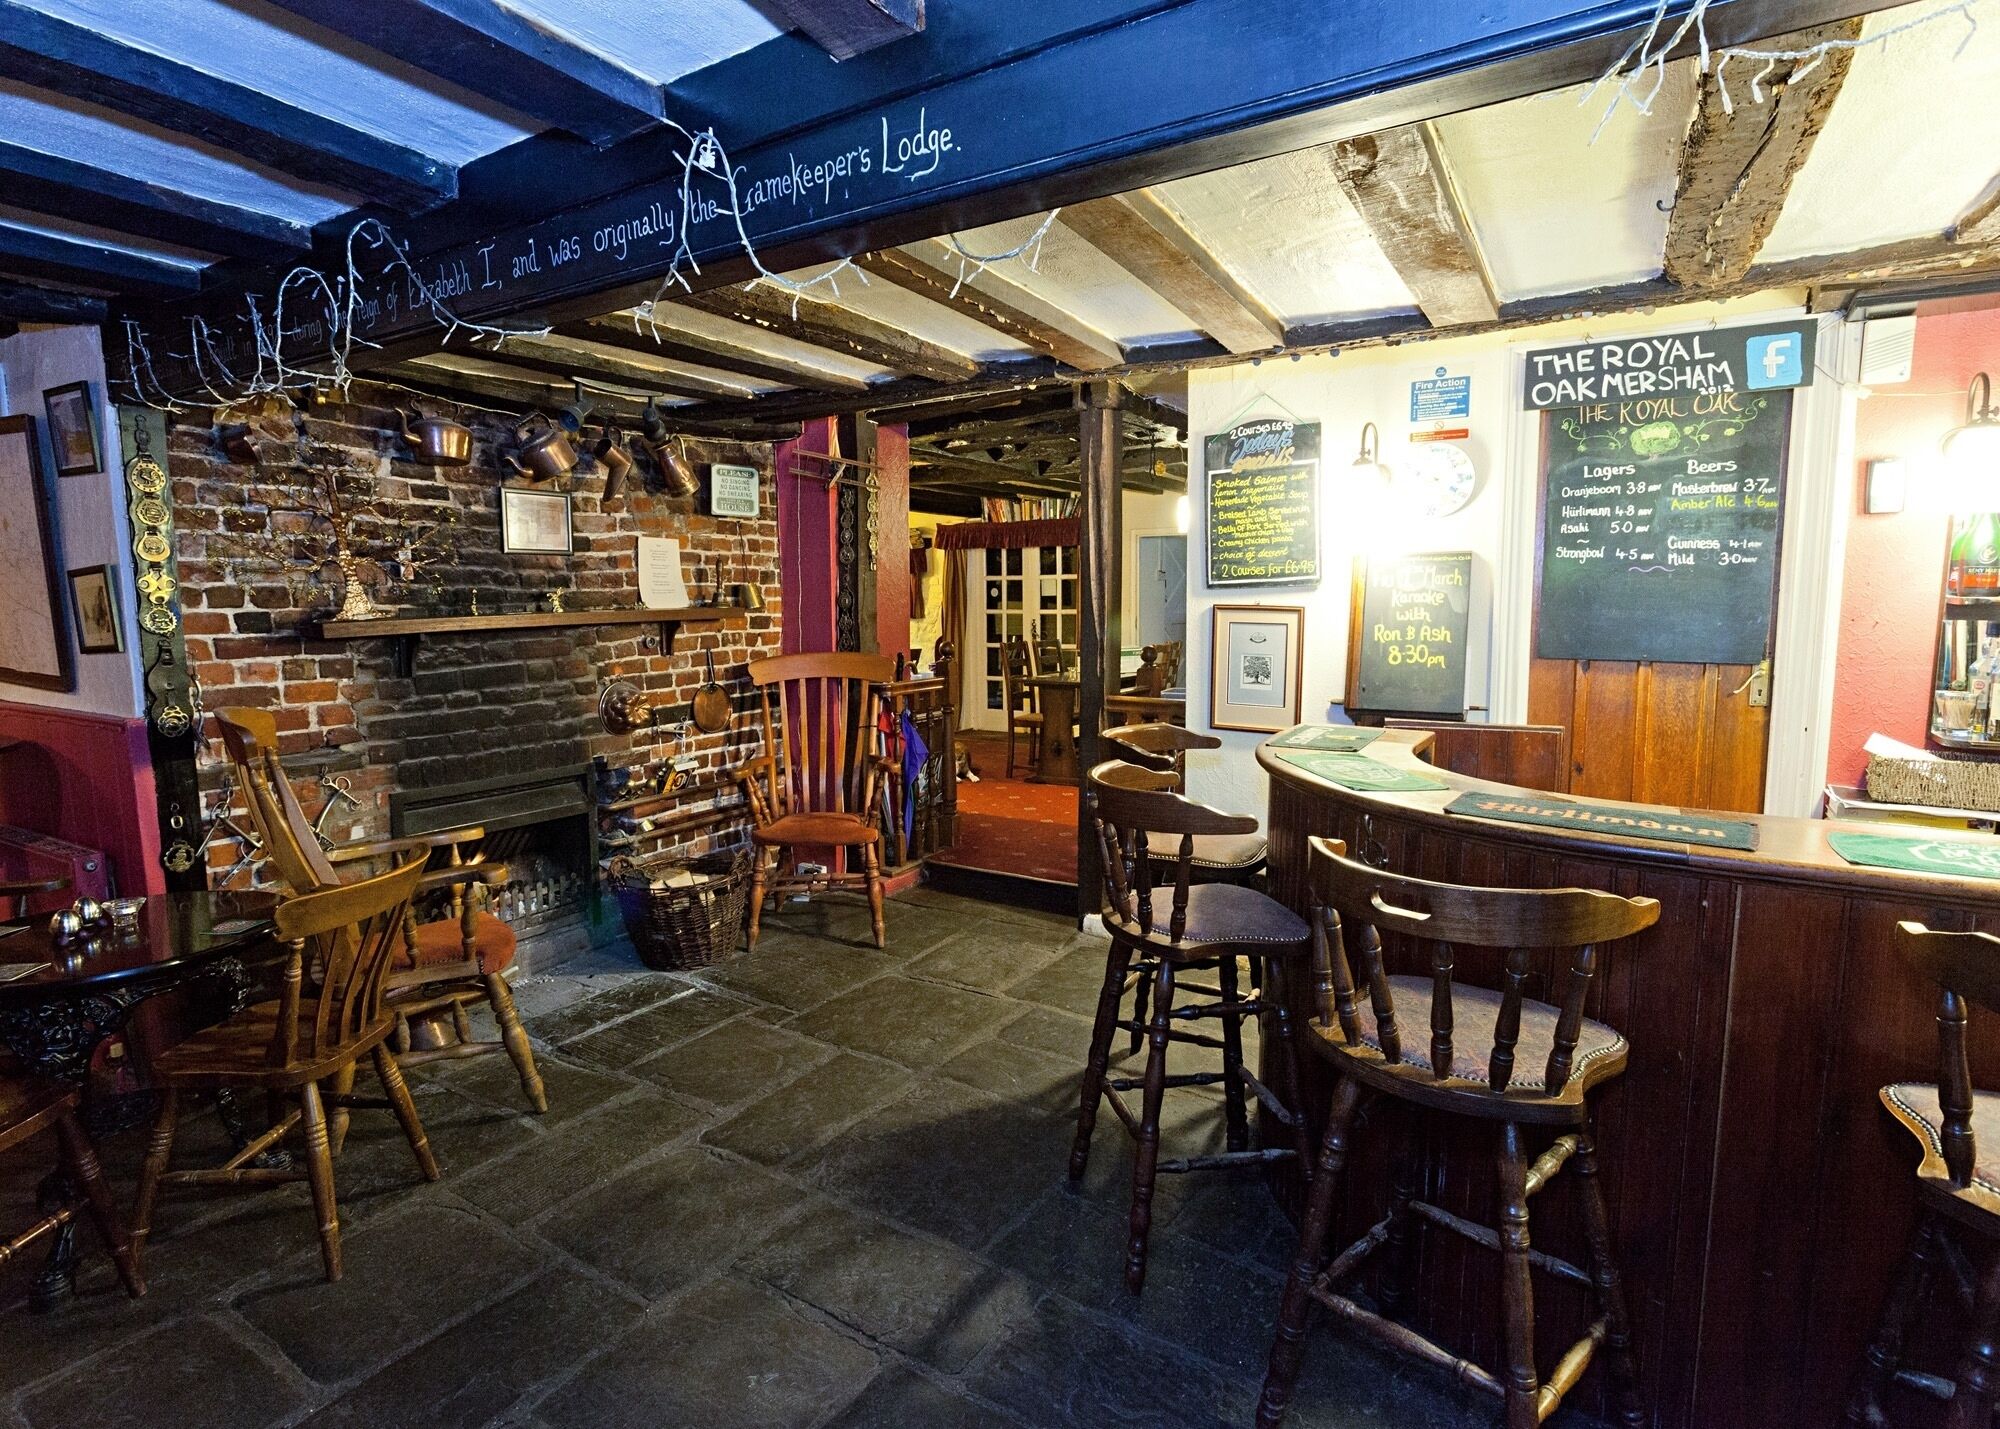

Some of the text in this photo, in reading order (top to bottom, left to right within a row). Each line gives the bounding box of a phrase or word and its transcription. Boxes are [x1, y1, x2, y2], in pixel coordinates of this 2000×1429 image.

[355, 299, 382, 330] reign
[386, 280, 399, 322] of
[407, 256, 473, 311] Elizabeth
[512, 238, 542, 278] and
[549, 236, 581, 267] was
[593, 202, 676, 261] originally
[687, 189, 718, 225] the
[881, 107, 962, 182] Lodge.
[1533, 335, 1716, 377] THE ROYAL
[1415, 379, 1466, 391] Fire Action
[1531, 360, 1735, 407] OAK MERSHAM
[1698, 383, 1734, 396] 2012
[1578, 393, 1745, 427] THE ROYAL OAK
[1229, 429, 1238, 440] 2
[1237, 424, 1271, 437] Courses
[719, 468, 753, 478] PLEASE
[1583, 464, 1636, 481] Lagers
[1686, 459, 1738, 475] Beers
[1216, 471, 1309, 489] Smoked Salmon with
[729, 484, 751, 492] DANCING
[1561, 485, 1622, 498] Oranjeboom
[1672, 481, 1739, 496] Masterbrew
[721, 503, 750, 512] HOUSE
[1671, 498, 1713, 511] Amber
[1715, 495, 1736, 508] Ale
[1218, 510, 1247, 520] Braised
[1247, 508, 1267, 517] Lamb
[1254, 515, 1268, 523] and
[1562, 505, 1611, 518] Hürlimann
[1217, 524, 1237, 535] Belly
[1247, 522, 1261, 531] Pork
[1560, 522, 1589, 534] Asahi
[1218, 539, 1244, 548] Creamy
[1667, 535, 1721, 549] Guinness
[1219, 551, 1244, 560] choice
[1257, 546, 1289, 559] dessert
[1555, 545, 1606, 564] Strongbow
[1667, 552, 1695, 566] Mild
[1221, 564, 1229, 578] 2
[1231, 565, 1266, 577] Courses
[1267, 562, 1285, 578] for
[1423, 565, 1463, 589] March
[1391, 588, 1445, 608] Karaoke
[1396, 606, 1432, 622] with
[1374, 623, 1403, 643] Ron
[1420, 625, 1453, 643] Ash
